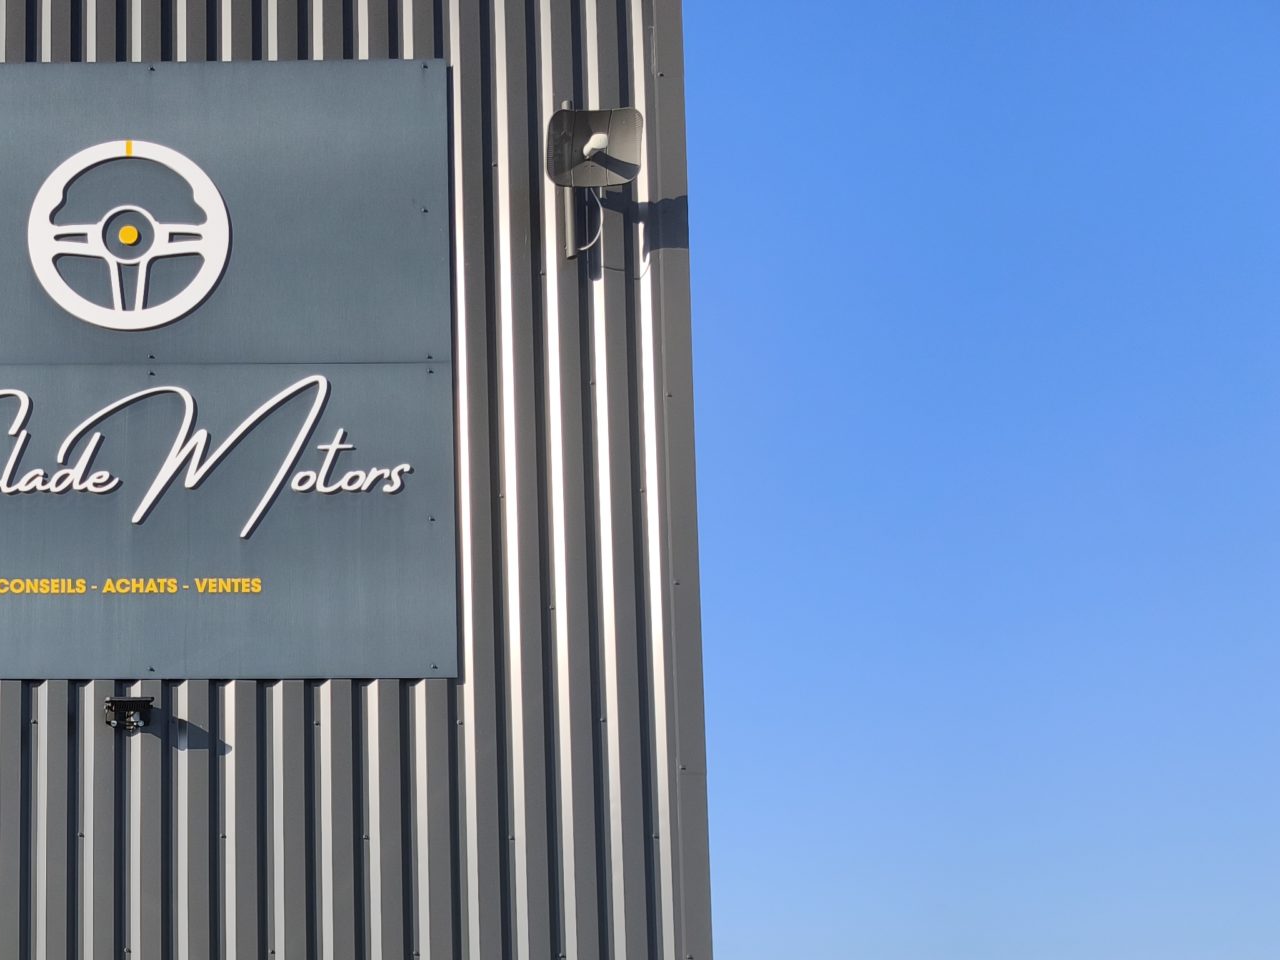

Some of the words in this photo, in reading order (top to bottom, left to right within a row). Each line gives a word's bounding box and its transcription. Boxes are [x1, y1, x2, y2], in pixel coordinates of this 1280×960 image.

[57, 374, 412, 538] Motors
[102, 578, 178, 593] ACHATS
[195, 577, 262, 593] VENTES
